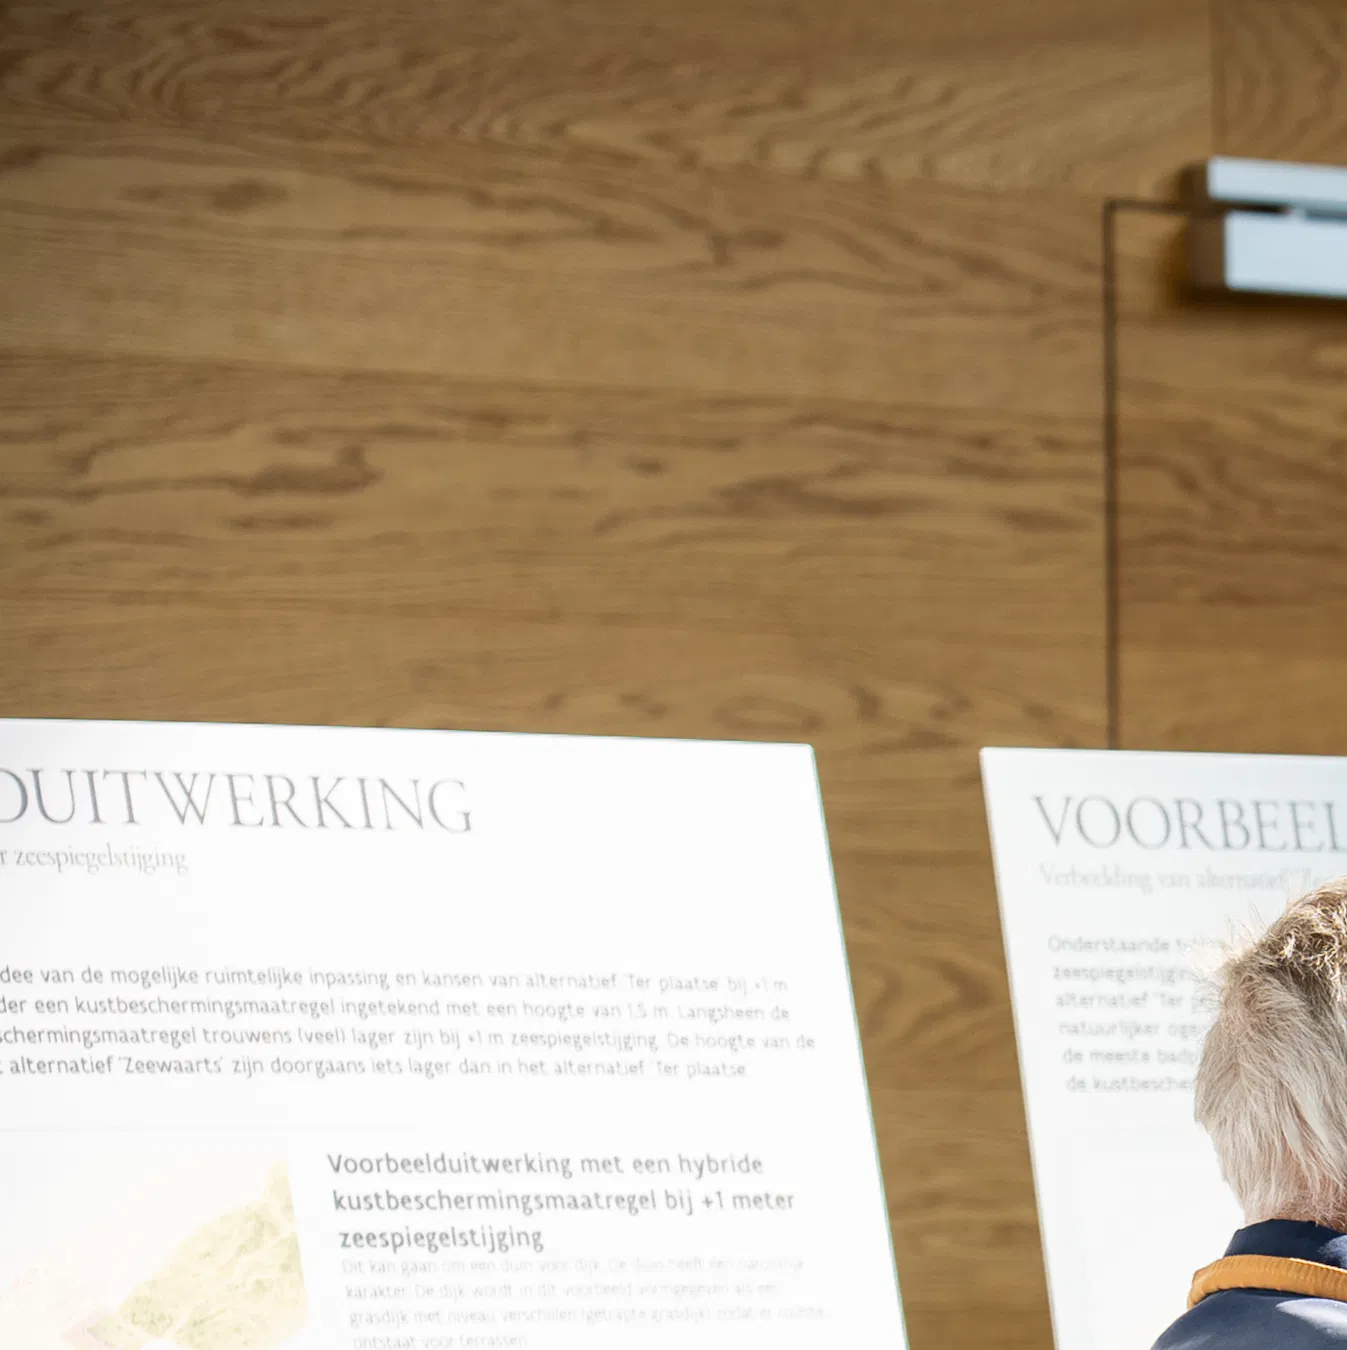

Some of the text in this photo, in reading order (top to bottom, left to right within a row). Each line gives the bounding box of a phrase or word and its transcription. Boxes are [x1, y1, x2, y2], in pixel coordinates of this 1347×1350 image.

[15, 842, 189, 876] zeespiegelstijging
[1047, 935, 1170, 953] Onderstaande
[40, 968, 74, 984] van
[82, 966, 103, 984] de
[110, 966, 199, 989] mogelijke
[205, 966, 302, 989] ruimtelijke
[309, 967, 389, 990] inpassing
[396, 972, 416, 986] en
[423, 969, 483, 988] kansen
[488, 972, 520, 988] van
[526, 971, 618, 989] alternatief
[35, 999, 68, 1014] een
[75, 996, 335, 1019] kustbeschermingsmaatregel
[341, 998, 440, 1020] ingetekend
[446, 1001, 479, 1016] met
[487, 1003, 517, 1017] een
[523, 1001, 585, 1022] hoogte
[593, 1004, 621, 1018] van
[771, 1005, 790, 1021] de
[203, 1028, 291, 1045] trouwens
[352, 1029, 396, 1049] lager
[404, 1030, 434, 1050] zijn
[440, 1029, 460, 1049] bij
[488, 1033, 504, 1046] m
[695, 1033, 756, 1054] hoogte
[762, 1036, 790, 1050] van
[10, 1056, 114, 1075] alternatief
[232, 1057, 264, 1080] zijn
[270, 1057, 366, 1079] doorgaans
[371, 1057, 402, 1075] iets
[408, 1058, 451, 1080] lager
[458, 1059, 491, 1075] dan
[498, 1059, 512, 1075] in
[518, 1059, 547, 1076] het
[554, 1060, 644, 1078] alternatief
[1091, 1075, 1196, 1092] kustbesche
[326, 1152, 764, 1180] Voorbeelduitwerking met een hybride
[332, 1189, 796, 1216] kustbeschermingsmaatregel bij +1 meter
[338, 1225, 544, 1253] zeespiegelstijging
